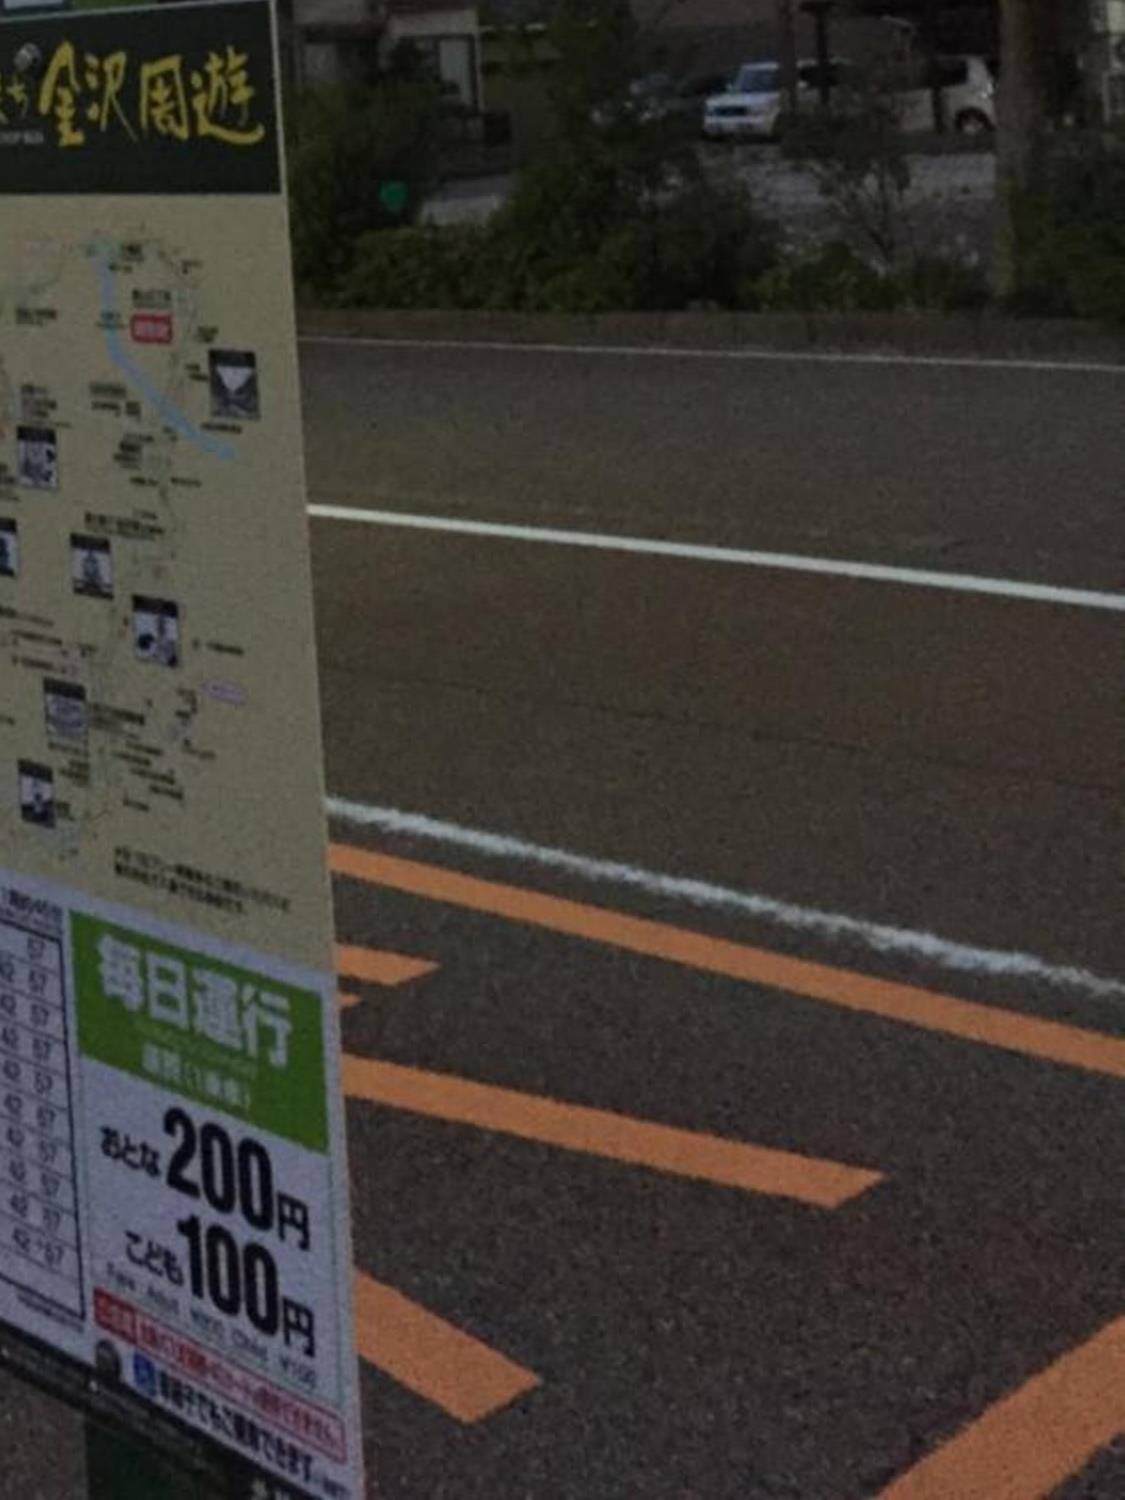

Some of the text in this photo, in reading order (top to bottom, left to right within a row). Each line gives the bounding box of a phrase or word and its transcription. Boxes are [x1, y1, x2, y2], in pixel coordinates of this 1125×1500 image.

[38, 39, 266, 148] 金沢周遊
[97, 934, 292, 1071] 毎日運行
[100, 1106, 311, 1251] おとな 200円
[125, 1230, 185, 1288] こども
[177, 1214, 316, 1358] 100円
